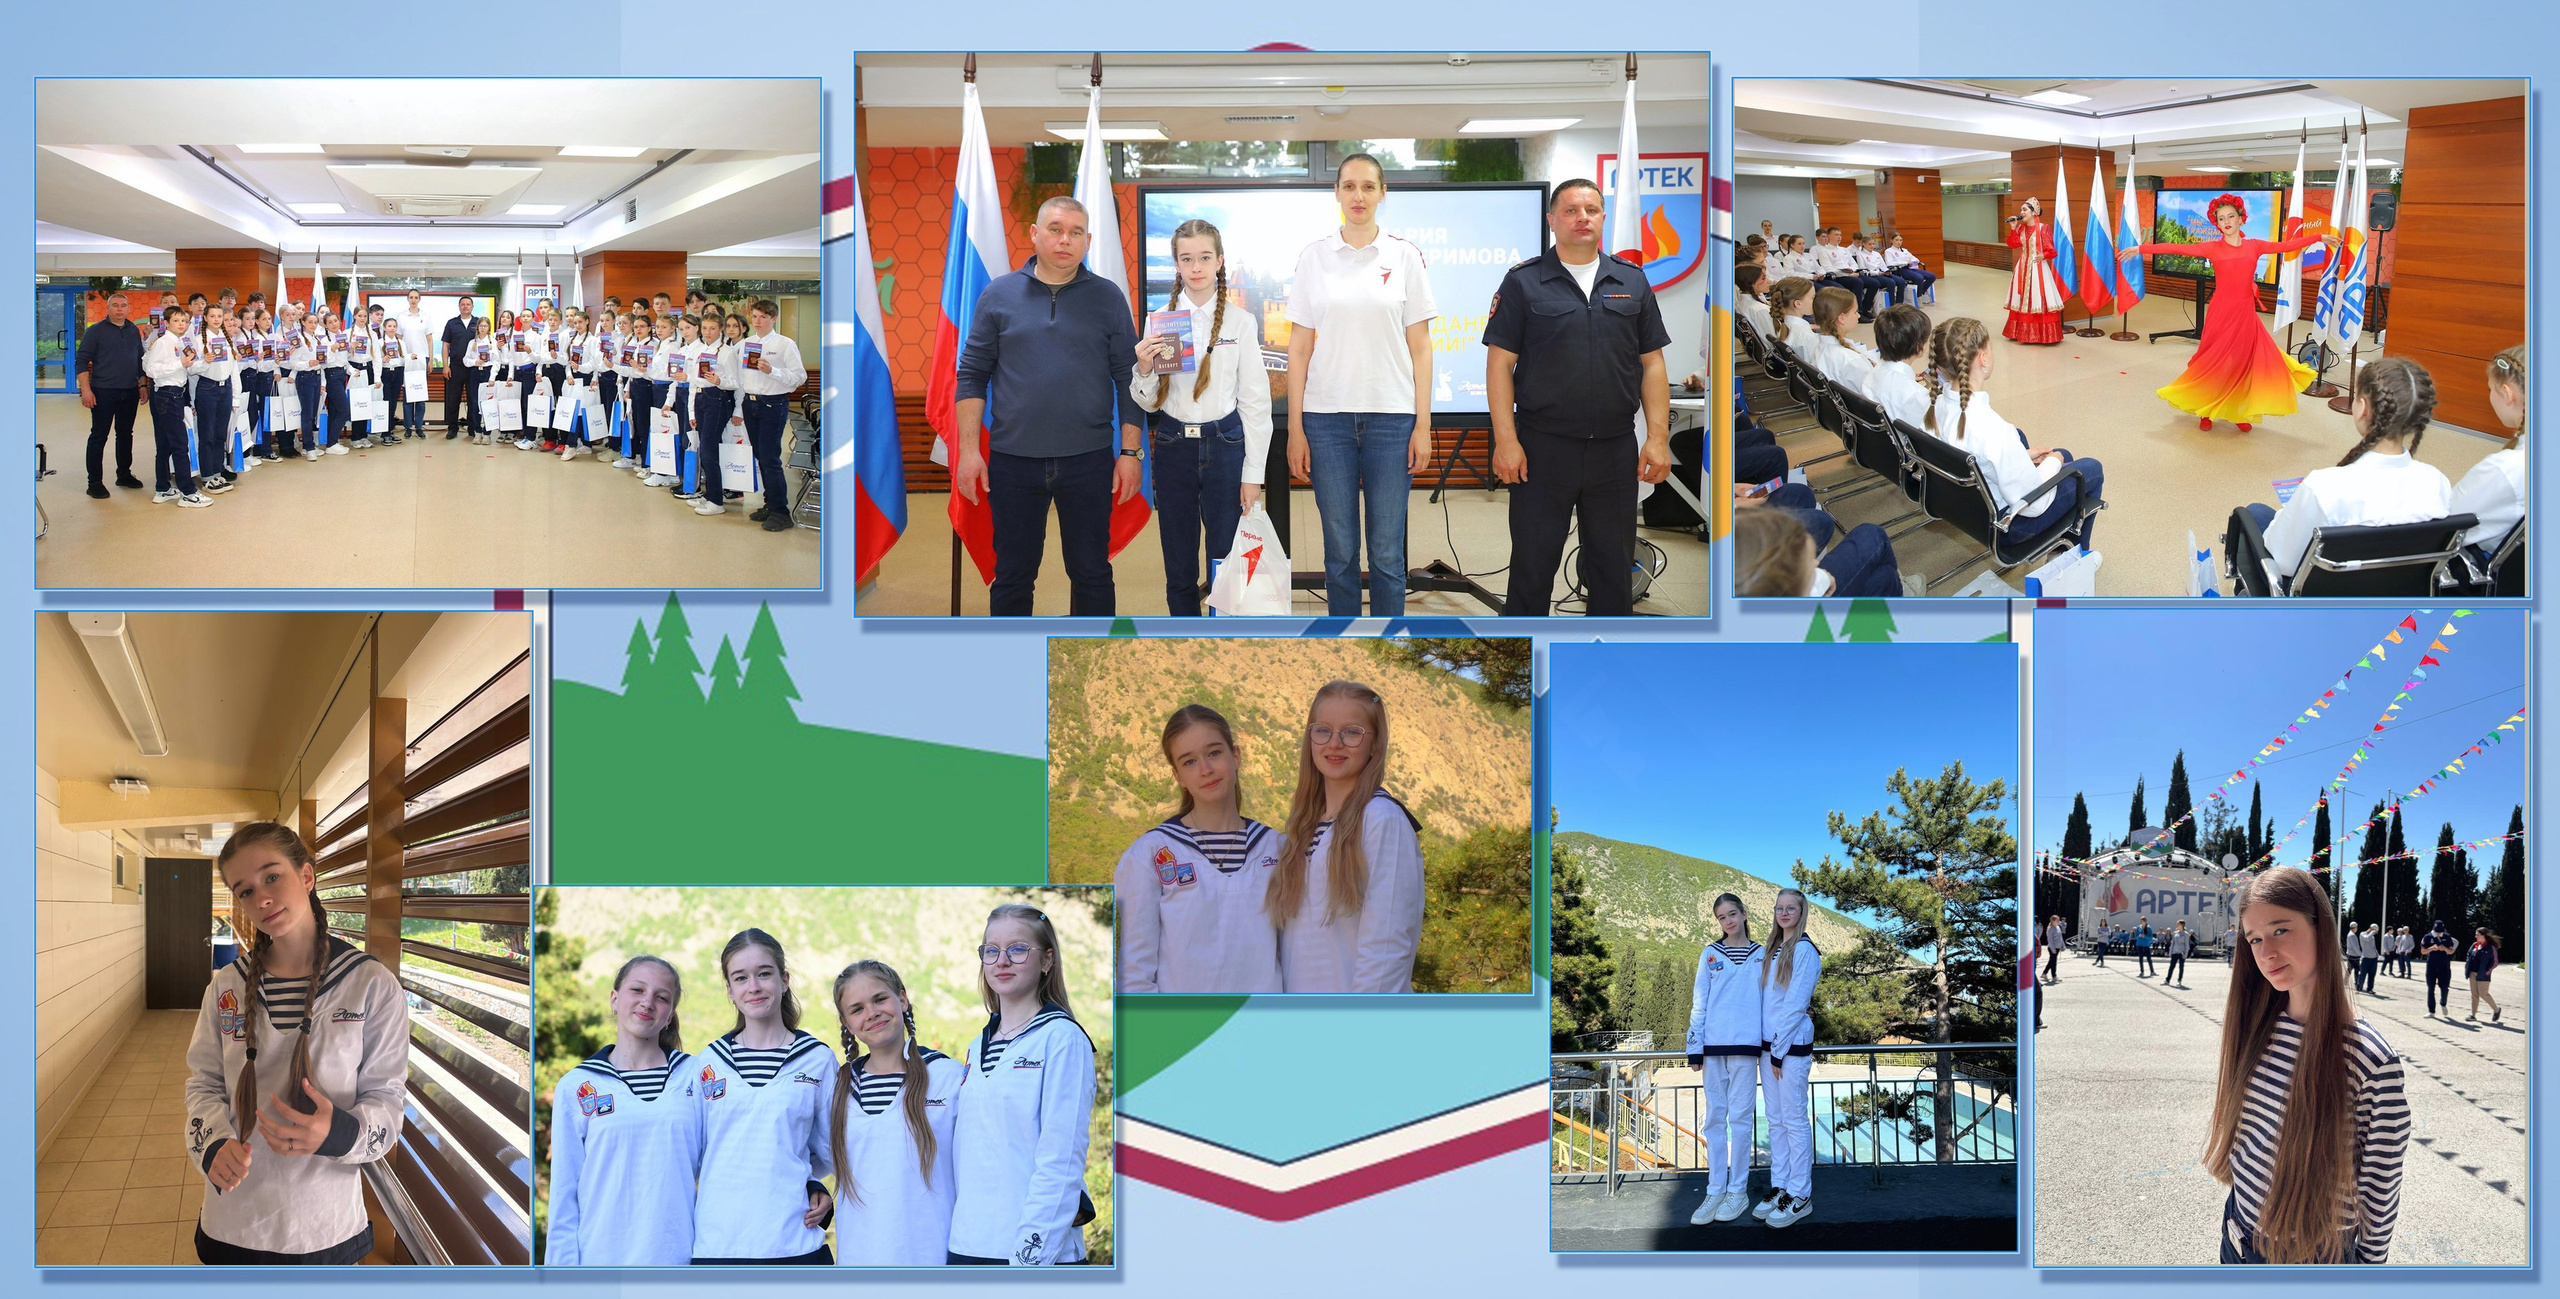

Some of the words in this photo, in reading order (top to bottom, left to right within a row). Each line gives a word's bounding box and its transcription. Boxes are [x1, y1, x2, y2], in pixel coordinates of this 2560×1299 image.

[1381, 227, 1448, 245] АРИЯ
[1421, 247, 1521, 265] ЕРИМОВА
[1431, 315, 1489, 336] ДАНЕ
[2136, 888, 2237, 917] АРТЕК
[1013, 1056, 1045, 1068] Артек
[794, 1072, 823, 1084] Артек
